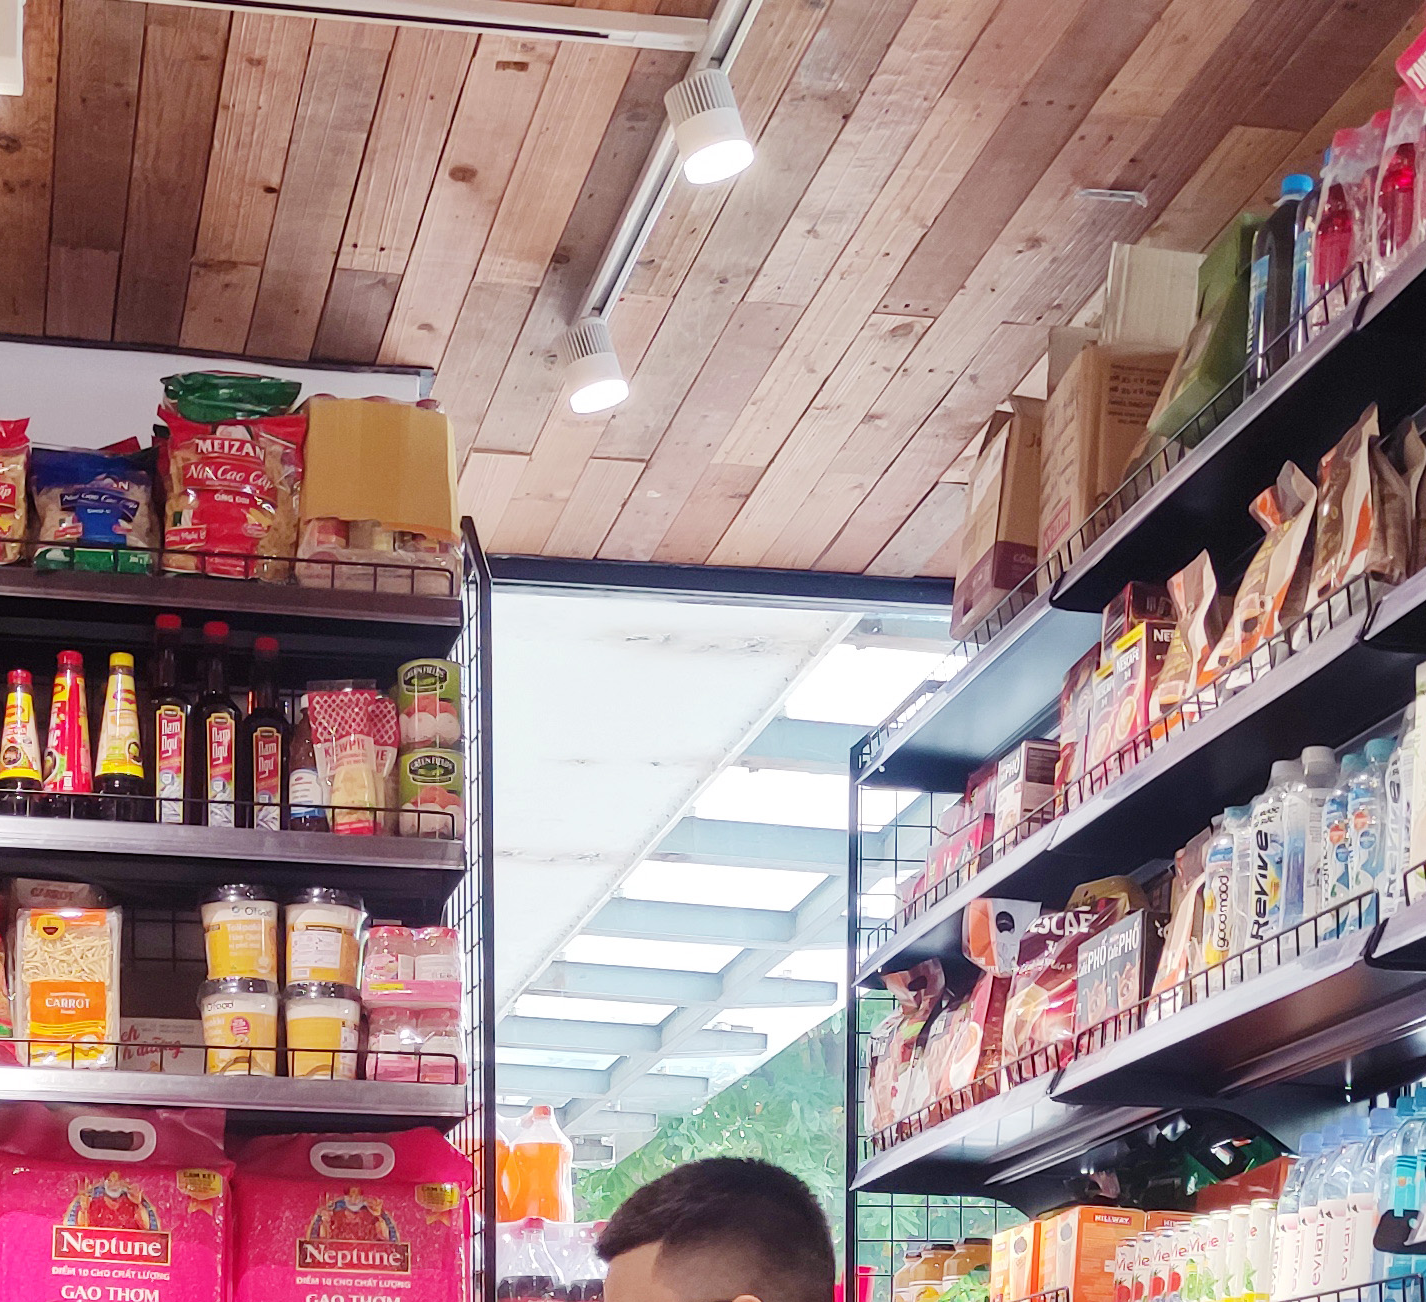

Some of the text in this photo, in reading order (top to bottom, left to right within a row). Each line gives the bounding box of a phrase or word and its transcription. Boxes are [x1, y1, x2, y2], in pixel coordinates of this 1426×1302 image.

[196, 438, 267, 461] MEIZAN
[45, 997, 91, 1010] CARROT
[1094, 1214, 1130, 1225] HILLWAY
[61, 1231, 162, 1257] Neptune
[303, 1244, 401, 1268] Neptune
[61, 1286, 159, 1302] GẠO THƠM
